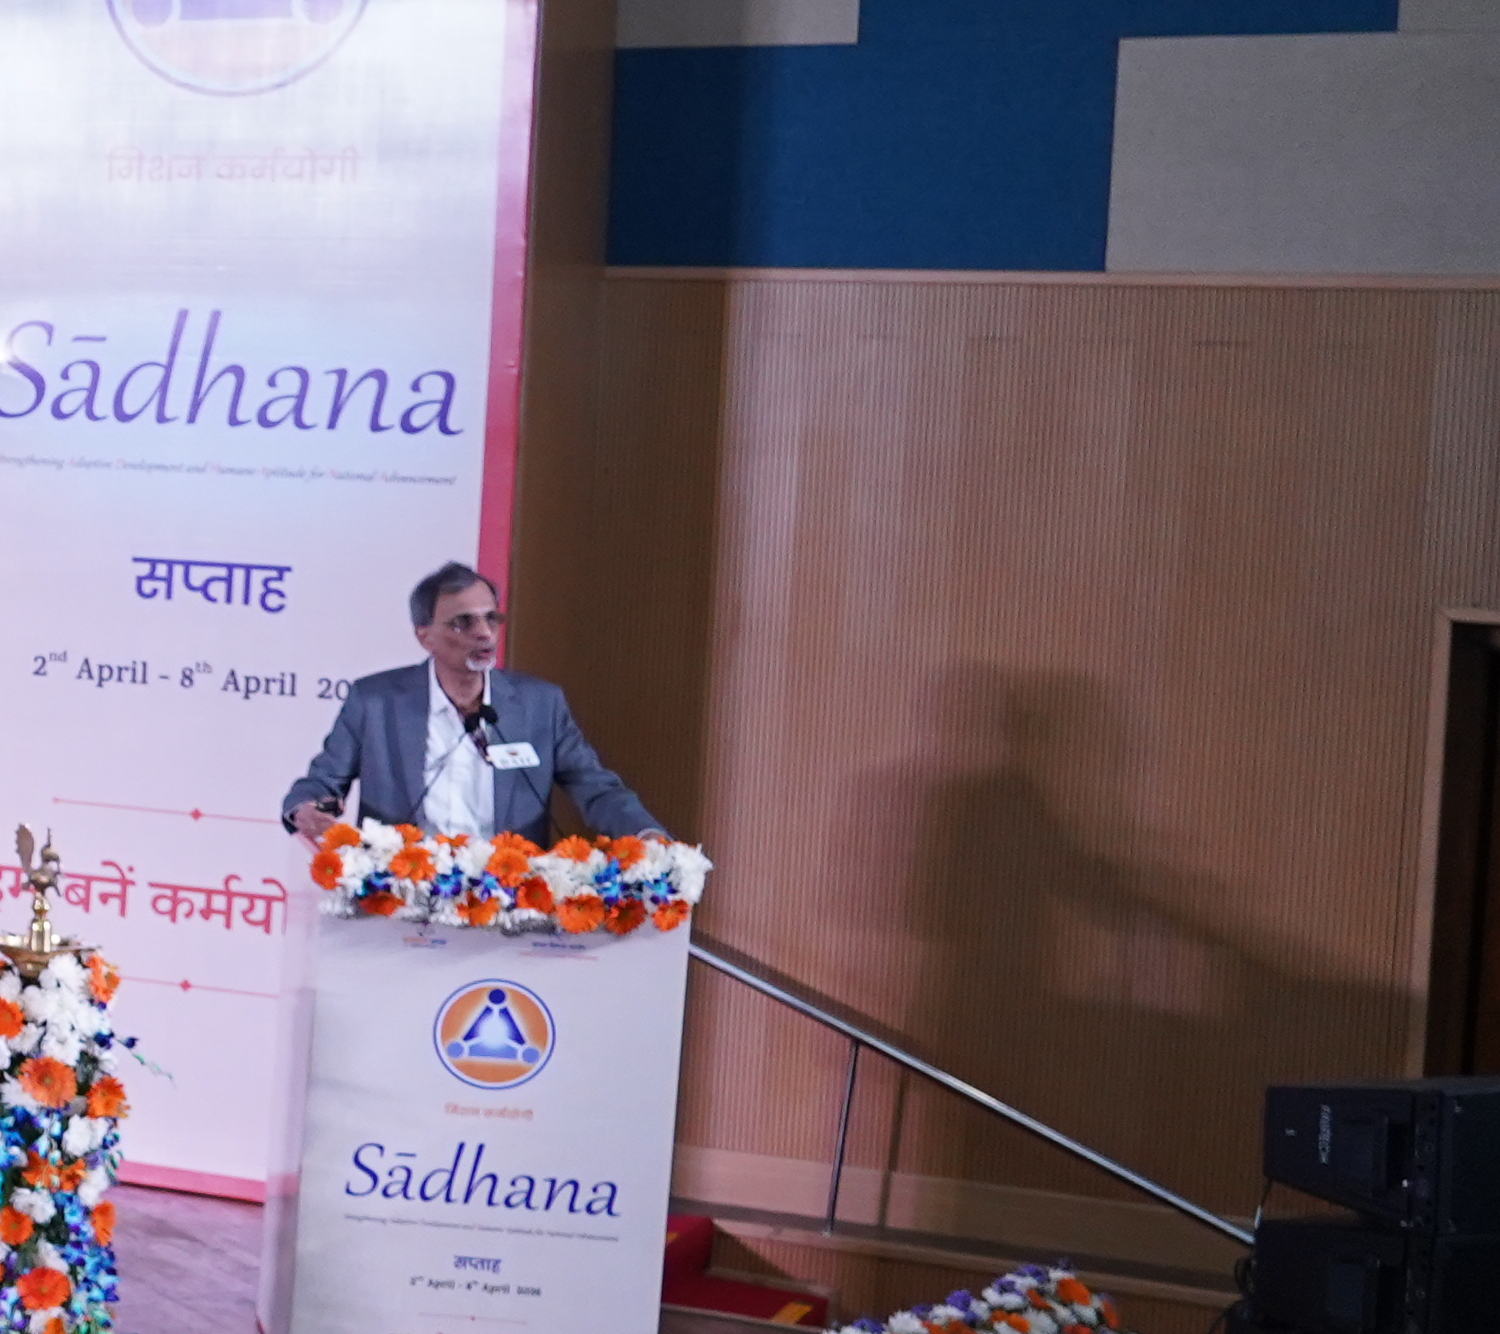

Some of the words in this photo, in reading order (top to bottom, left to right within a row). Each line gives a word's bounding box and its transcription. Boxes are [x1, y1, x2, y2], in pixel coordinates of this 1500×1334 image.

[131, 556, 293, 615] सप्ताह
[317, 677, 350, 701] 20
[344, 1141, 619, 1217] Sādhana
